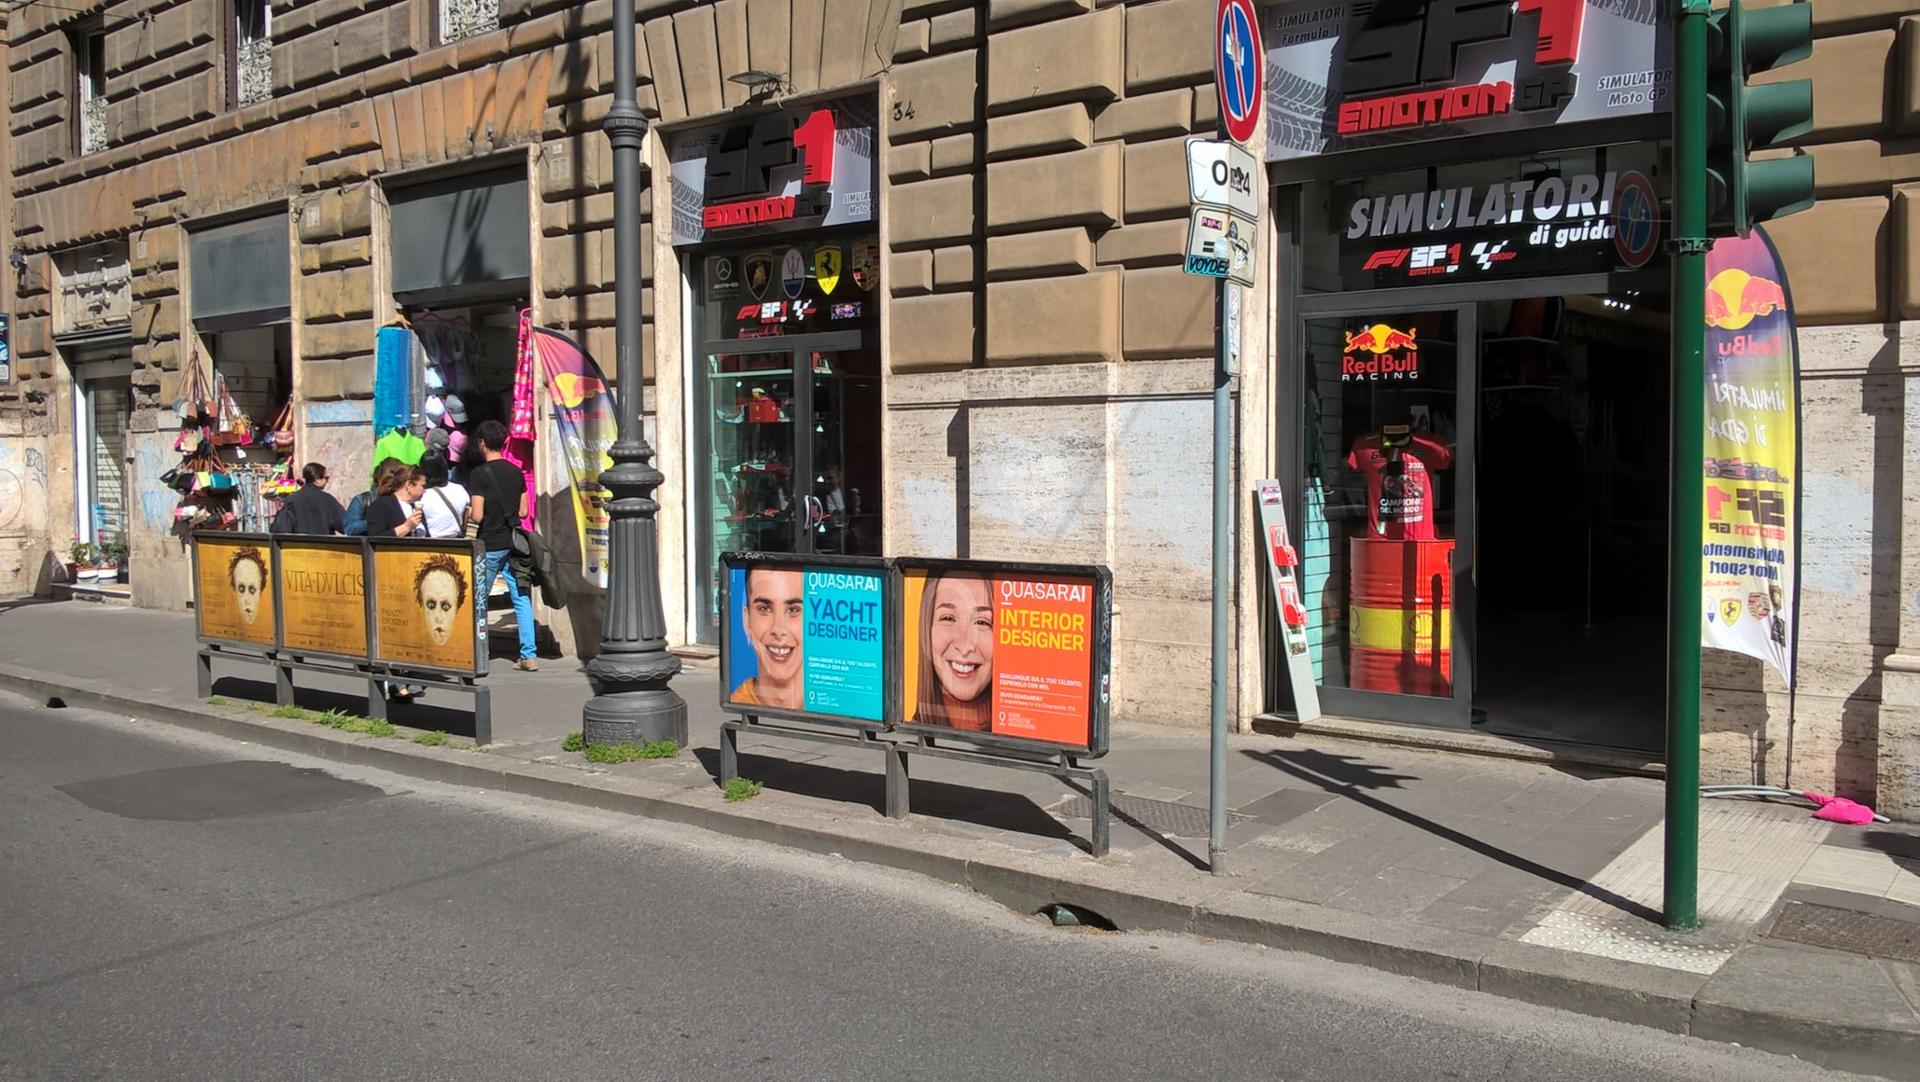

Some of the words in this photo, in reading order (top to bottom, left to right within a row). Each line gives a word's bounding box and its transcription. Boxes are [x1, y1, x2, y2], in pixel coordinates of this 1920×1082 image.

[1276, 4, 1346, 32] SIMULATORI
[1281, 27, 1330, 46] Formula
[1597, 68, 1672, 92] SIMULATOR
[1336, 79, 1517, 135] EMOTION
[1517, 71, 1578, 113] GP
[1607, 91, 1645, 106] Moto
[1647, 87, 1667, 104] GP
[893, 100, 916, 122] 34
[703, 109, 837, 201] SF1
[703, 196, 796, 230] EMOTION
[1345, 171, 1619, 240] SIMULATORI
[1529, 221, 1552, 245] di
[1555, 220, 1616, 249] guida
[1343, 353, 1378, 375] Red
[1382, 351, 1417, 373] Bull
[1341, 371, 1418, 382] RACING
[809, 597, 878, 625] YACHT
[1000, 608, 1084, 633] INTERIOR
[808, 622, 878, 643] DESIGNER
[1000, 628, 1085, 652] DESIGNER
